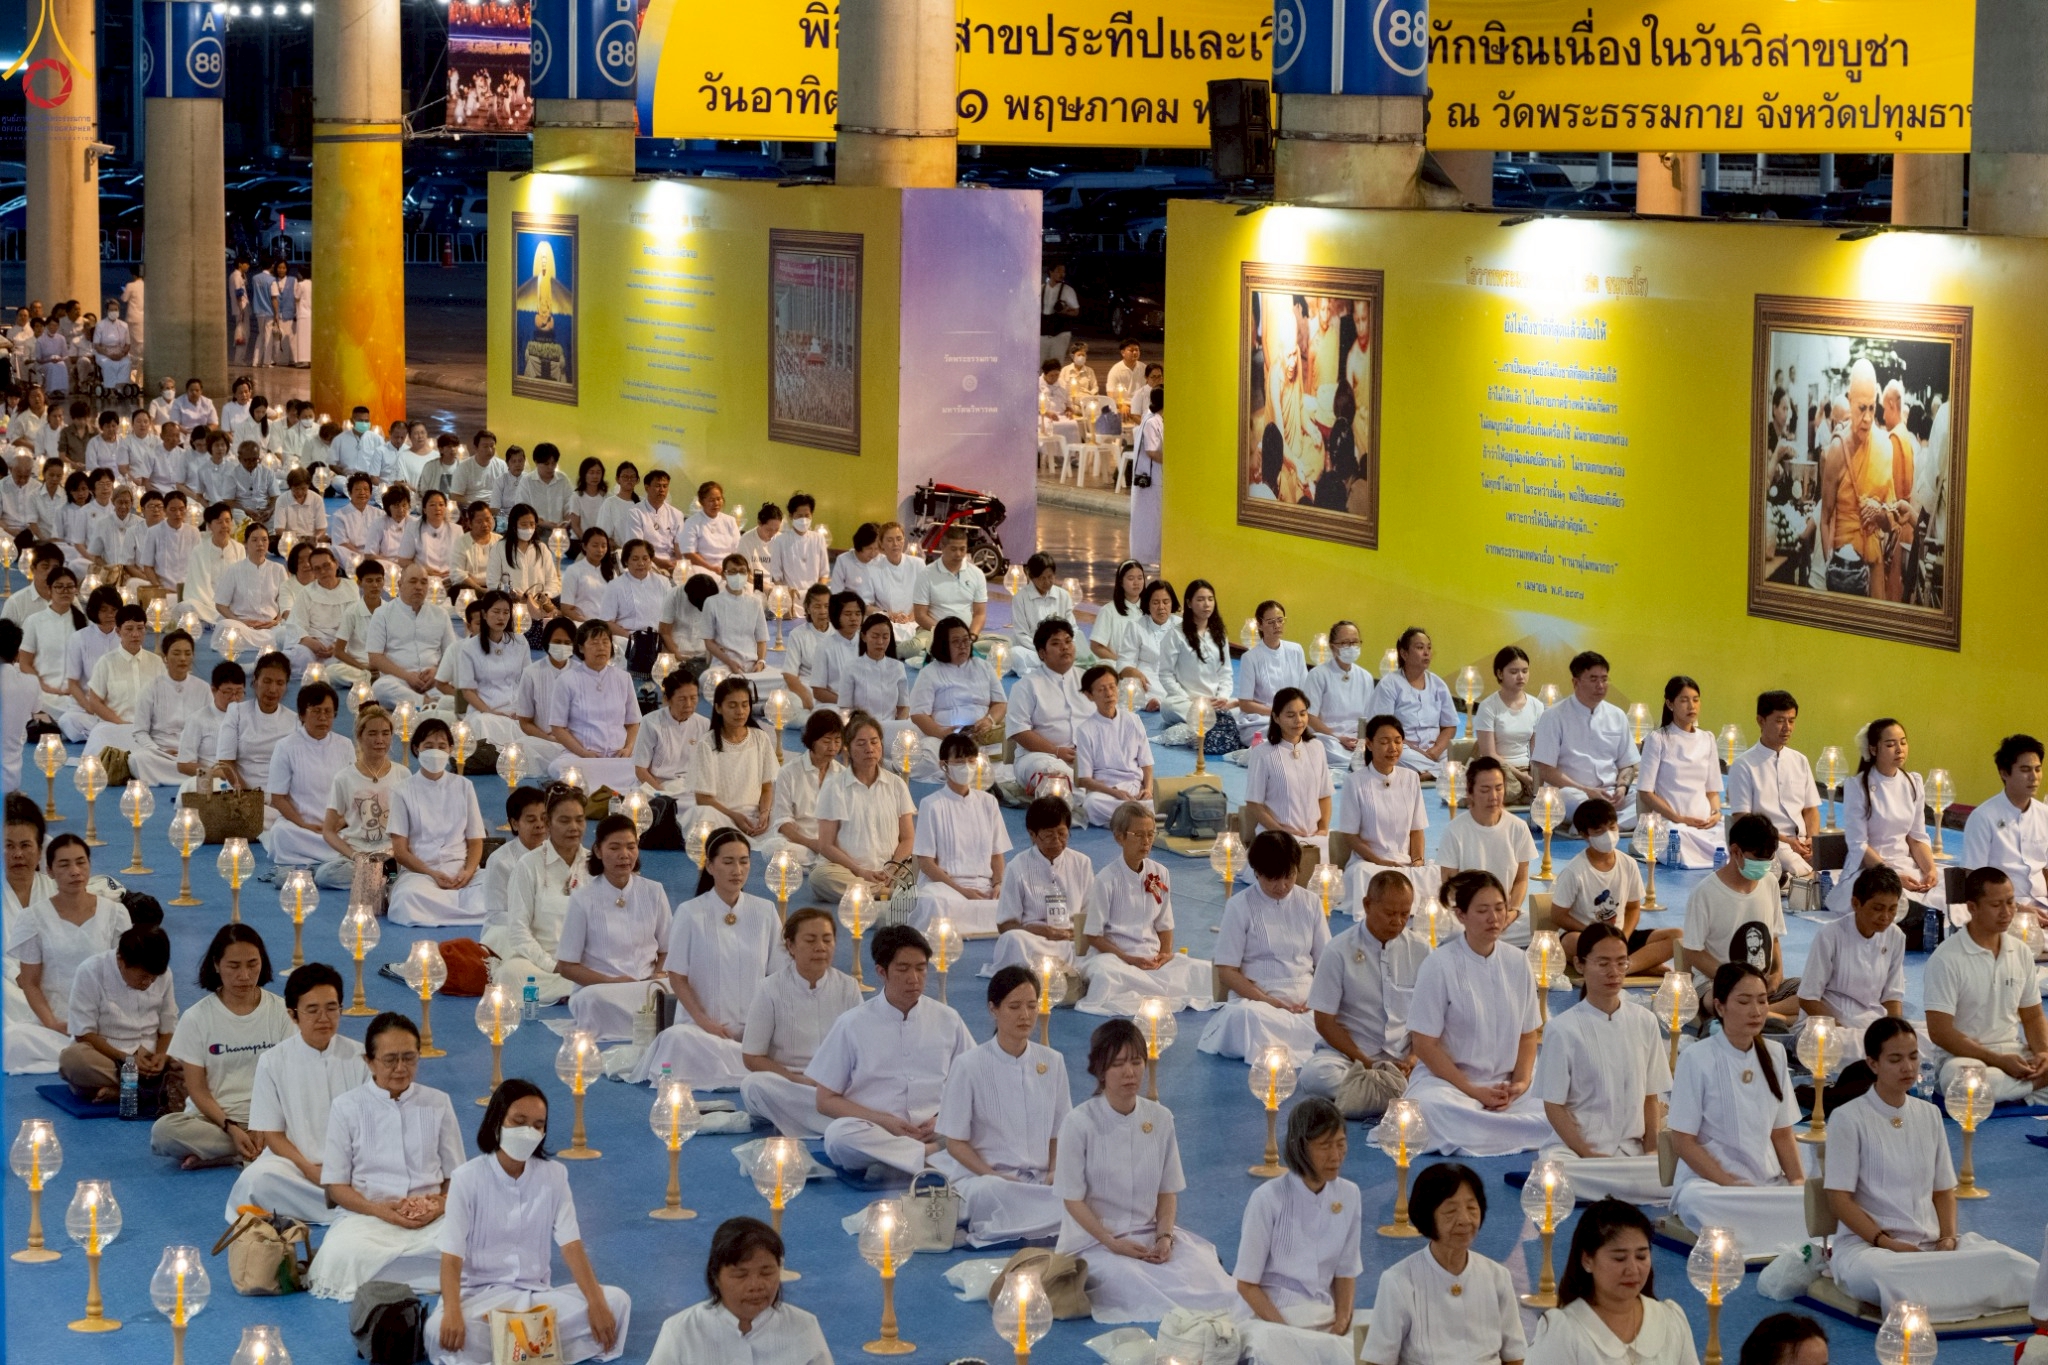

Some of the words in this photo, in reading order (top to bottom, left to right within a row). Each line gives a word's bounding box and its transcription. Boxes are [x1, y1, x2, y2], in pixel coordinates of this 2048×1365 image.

[202, 11, 216, 31] A
[1388, 9, 1427, 47] 88
[195, 52, 220, 73] 88
[607, 40, 635, 67] 88
[1004, 94, 1178, 132] พฤษภาคม
[1447, 102, 1480, 128] ณ
[1493, 90, 1743, 128] วัดพระธรรมกาย
